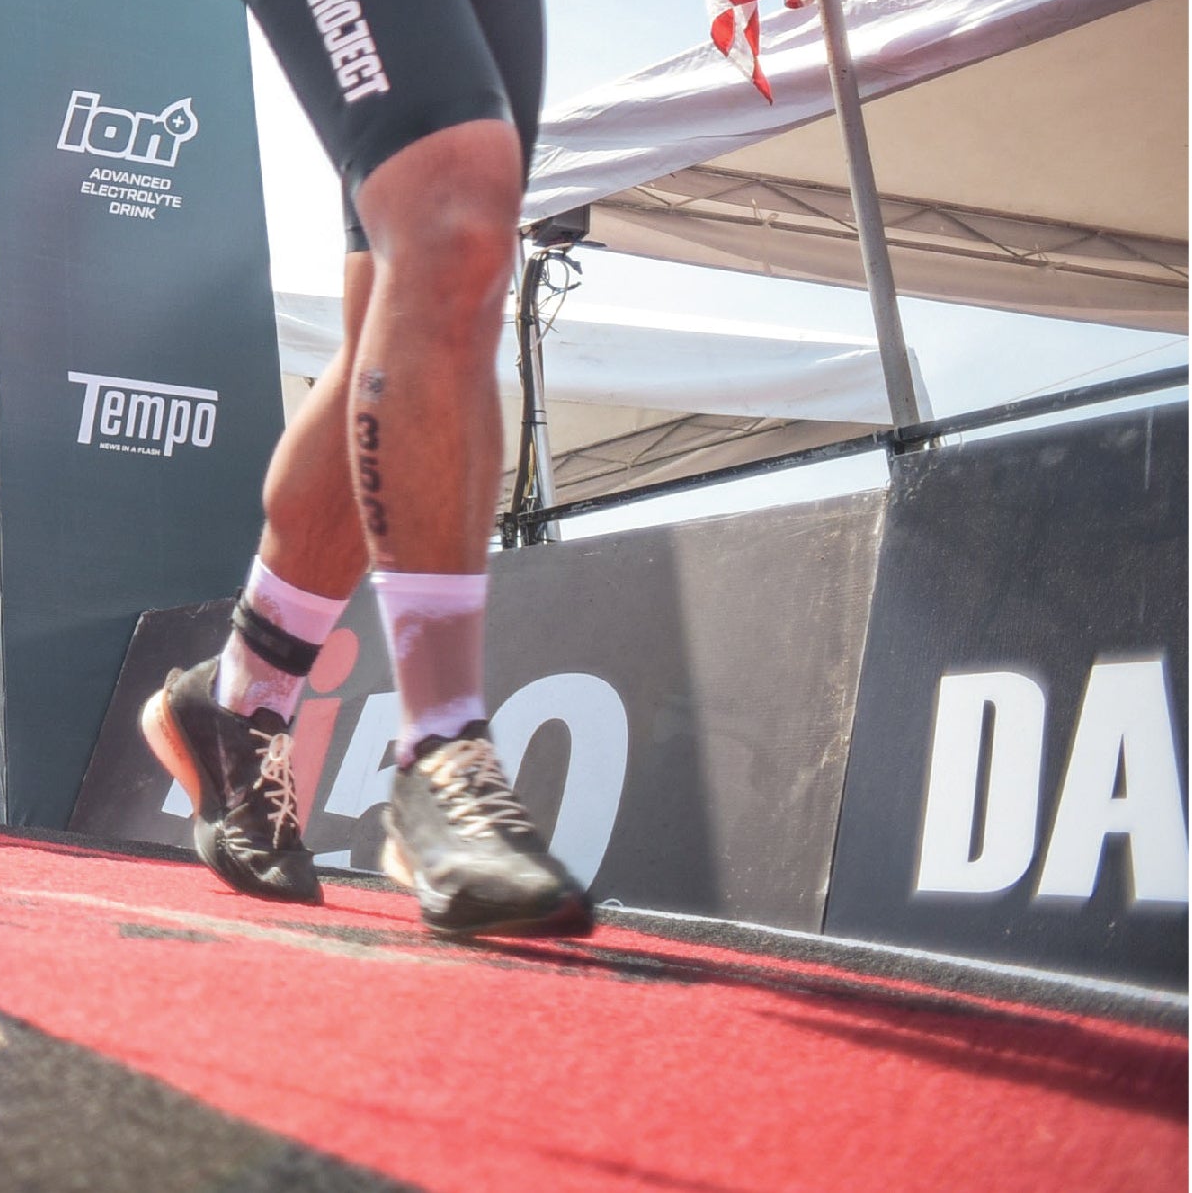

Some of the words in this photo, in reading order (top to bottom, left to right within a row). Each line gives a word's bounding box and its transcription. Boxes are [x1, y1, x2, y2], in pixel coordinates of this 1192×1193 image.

[89, 167, 172, 190] ADVANCED
[81, 181, 183, 208] ELECTROLYTE
[109, 201, 157, 219] DRINK
[67, 370, 219, 457] Tempo
[99, 441, 121, 452] NEWS
[916, 661, 1190, 902] DA
